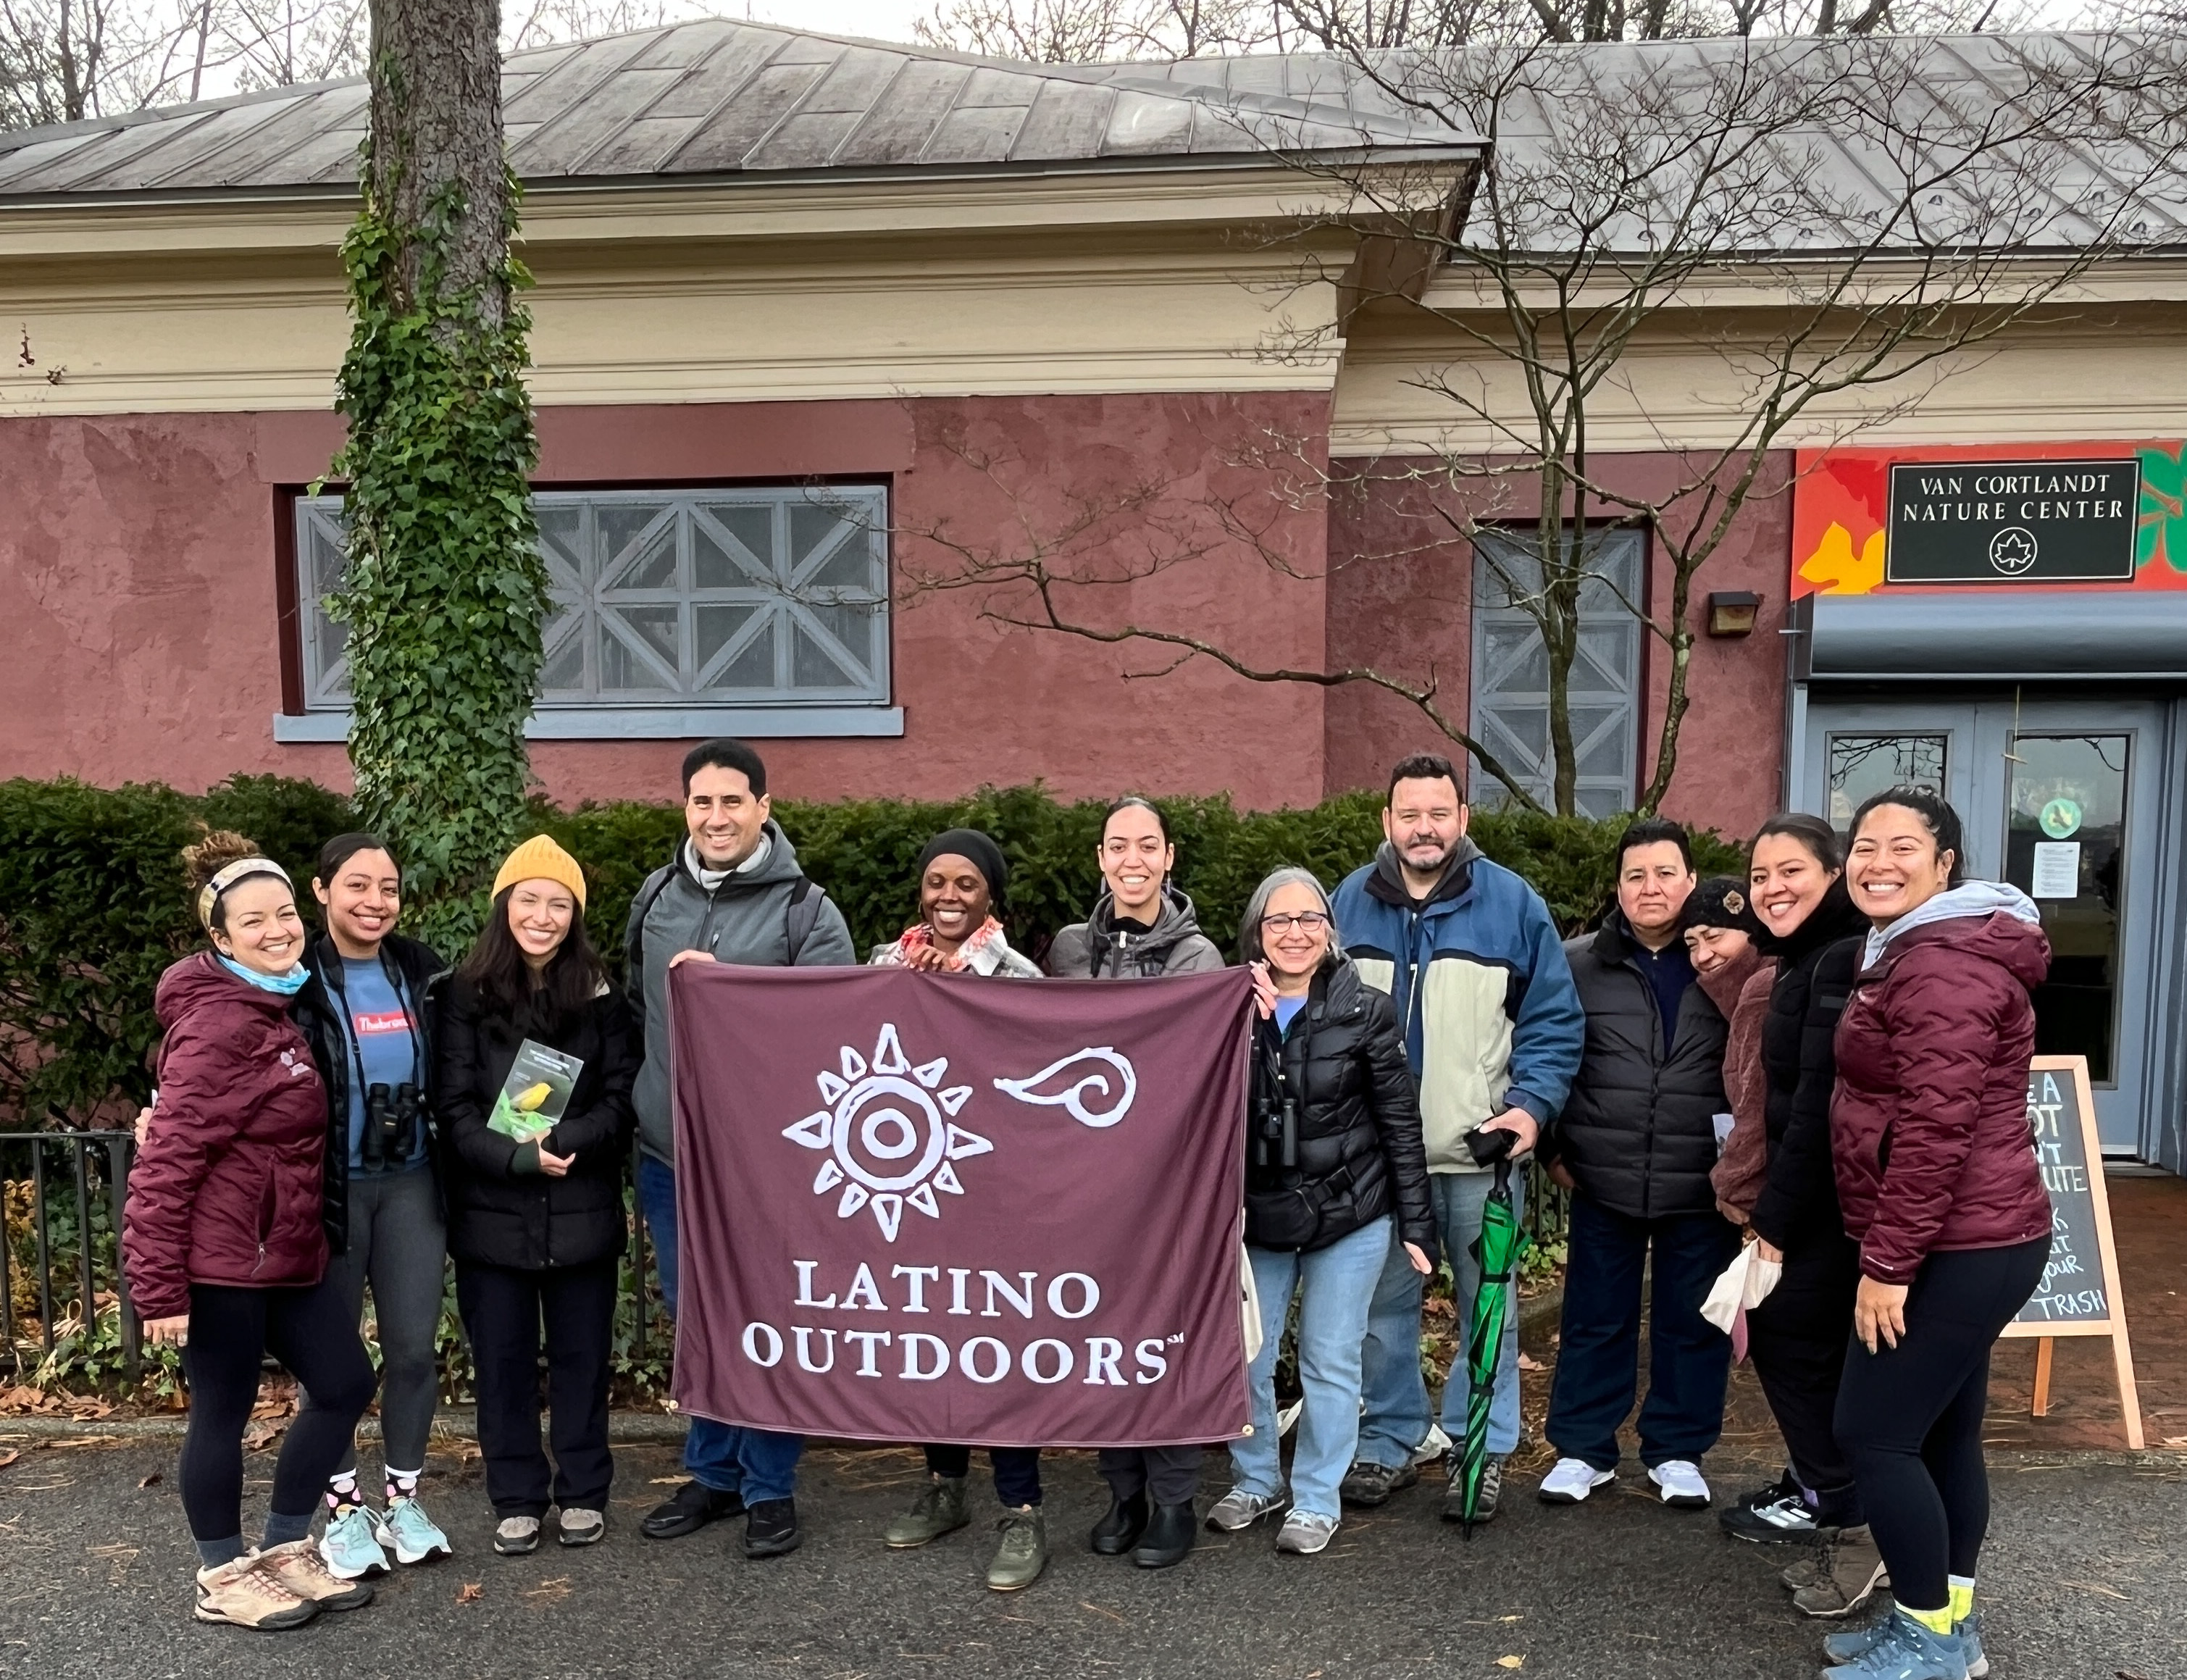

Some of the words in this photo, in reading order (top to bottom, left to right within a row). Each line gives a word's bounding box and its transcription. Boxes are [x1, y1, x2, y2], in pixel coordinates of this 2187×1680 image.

[1920, 477, 1962, 496] VAN
[1975, 475, 2109, 495] CORTLANDT
[1903, 502, 2006, 522] NATURE
[2020, 500, 2123, 519] CENTER
[2043, 1072, 2061, 1102] A
[2025, 1105, 2063, 1137] OT
[793, 1260, 1100, 1319] LATINO
[2031, 1290, 2107, 1320] TRASH
[742, 1321, 1168, 1387] OUTDOORS
